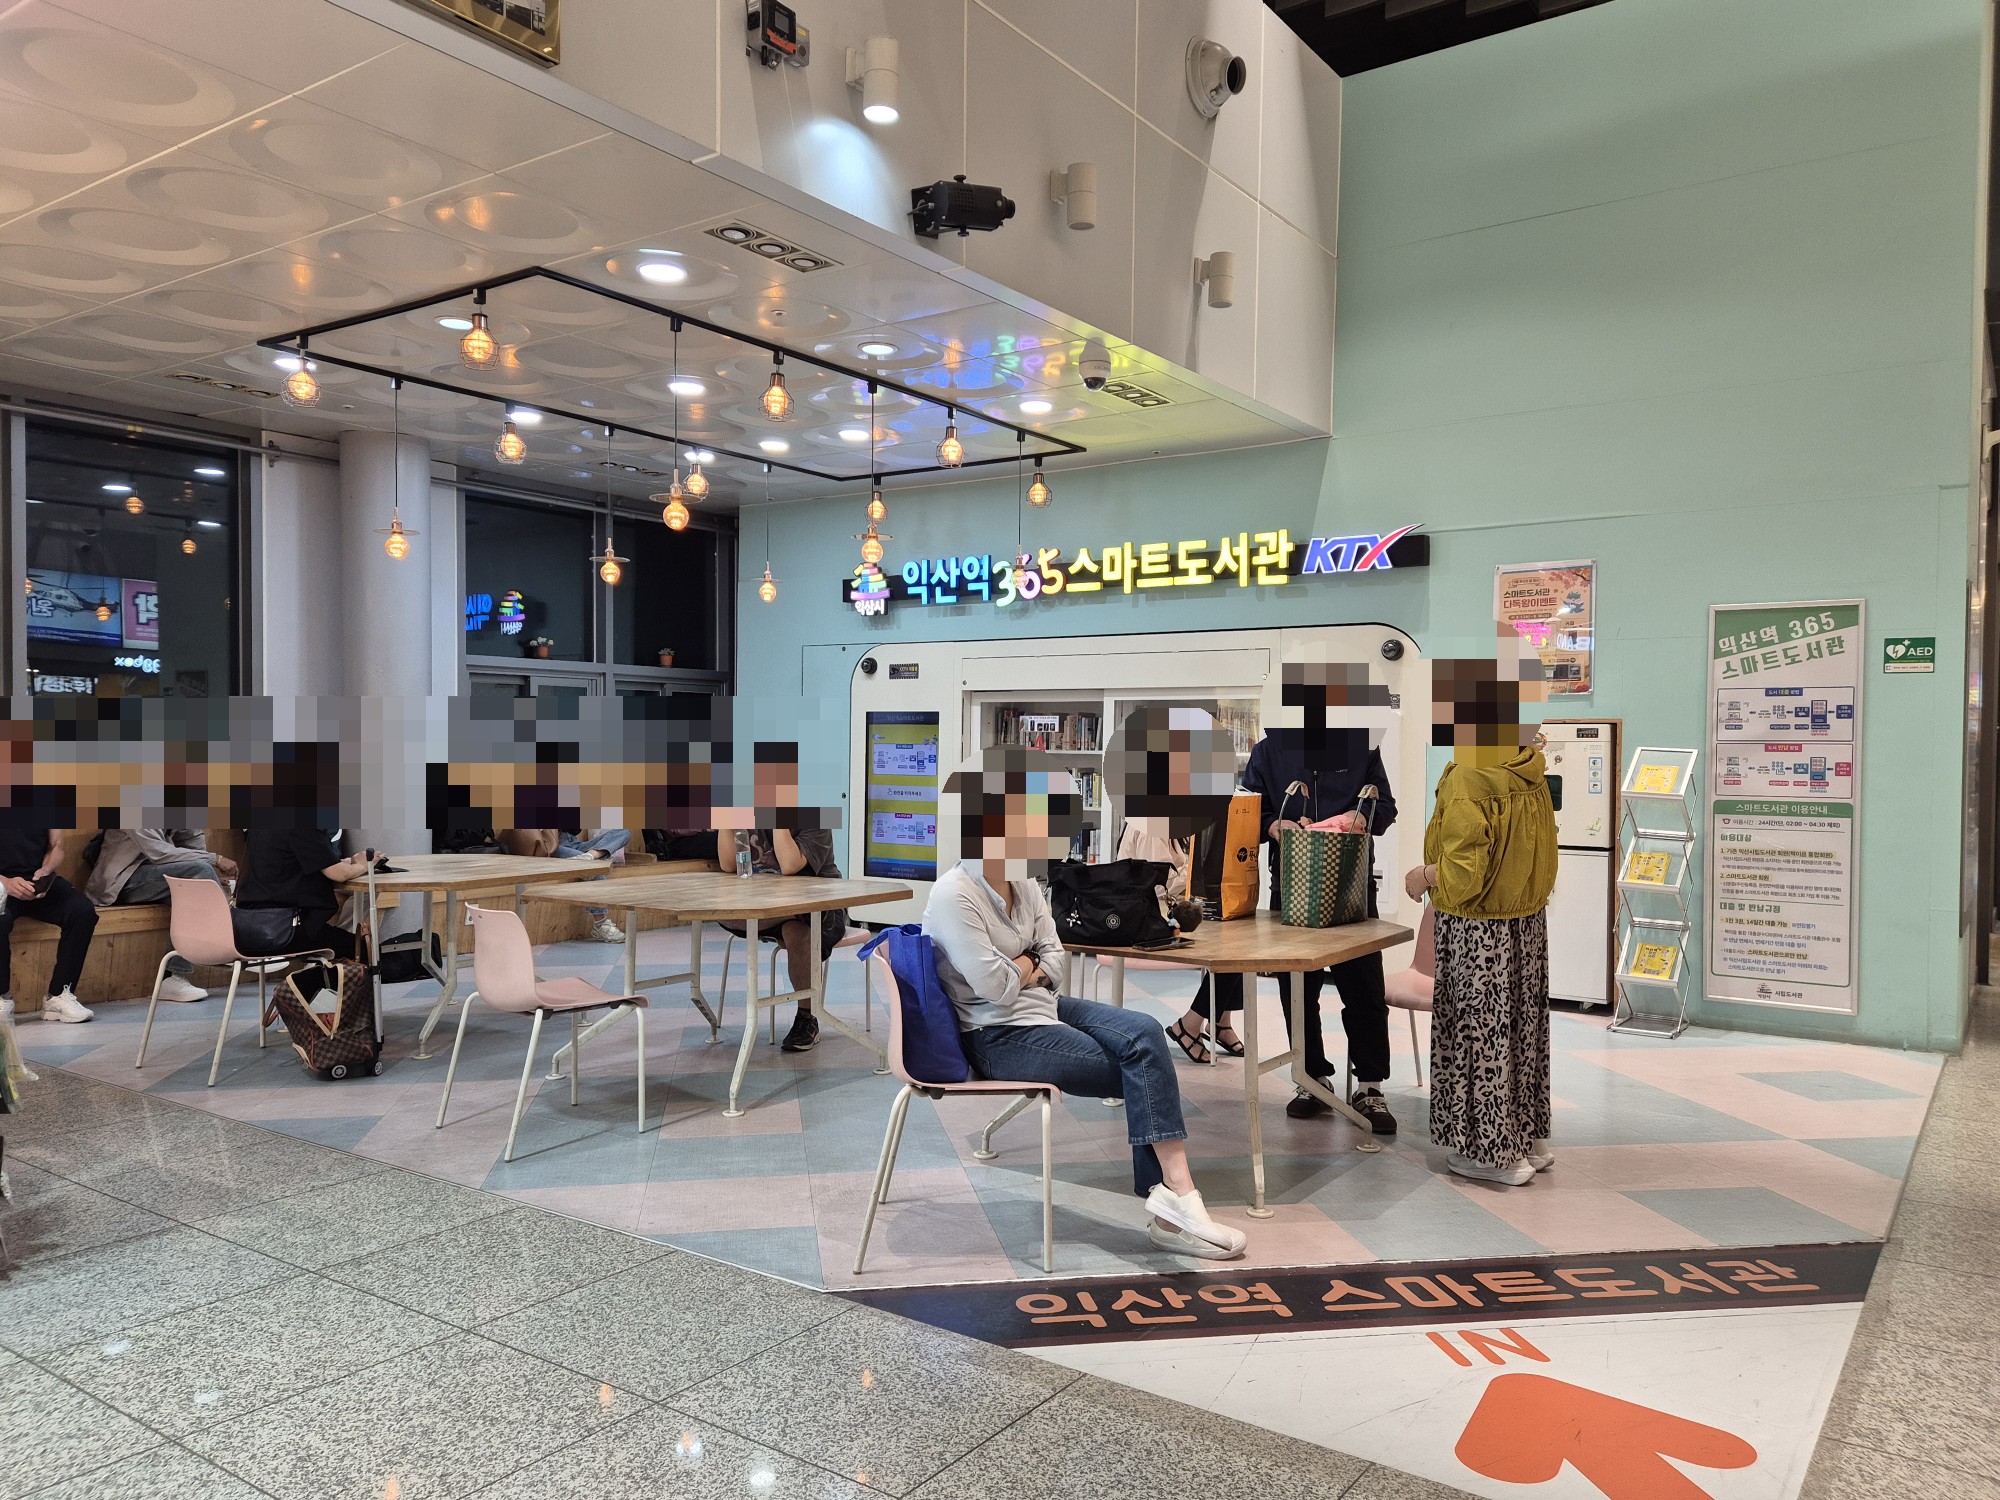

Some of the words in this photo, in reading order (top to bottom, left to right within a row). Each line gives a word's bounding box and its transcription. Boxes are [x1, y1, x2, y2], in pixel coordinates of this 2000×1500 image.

[1302, 523, 1421, 575] KTX
[1504, 588, 1550, 598] 스마트도서관
[854, 598, 886, 615] 익산시
[1504, 597, 1557, 608] 다독왕이벤트
[1719, 625, 1779, 653] 익산역
[1789, 612, 1835, 638] 365
[1722, 636, 1845, 679] 스마트도서관
[1907, 647, 1933, 656] AED
[1736, 804, 1788, 813] 스마트도서관
[1792, 805, 1828, 814] 이용안내
[1720, 902, 1735, 910] 대출
[1738, 903, 1745, 911] 및
[1748, 903, 1780, 913] 반납규정
[1775, 991, 1803, 999] 시립도서관
[1014, 1283, 1294, 1328] 익산역
[1322, 1260, 1823, 1313] 스마트도서관
[1423, 1327, 1552, 1368] IN
